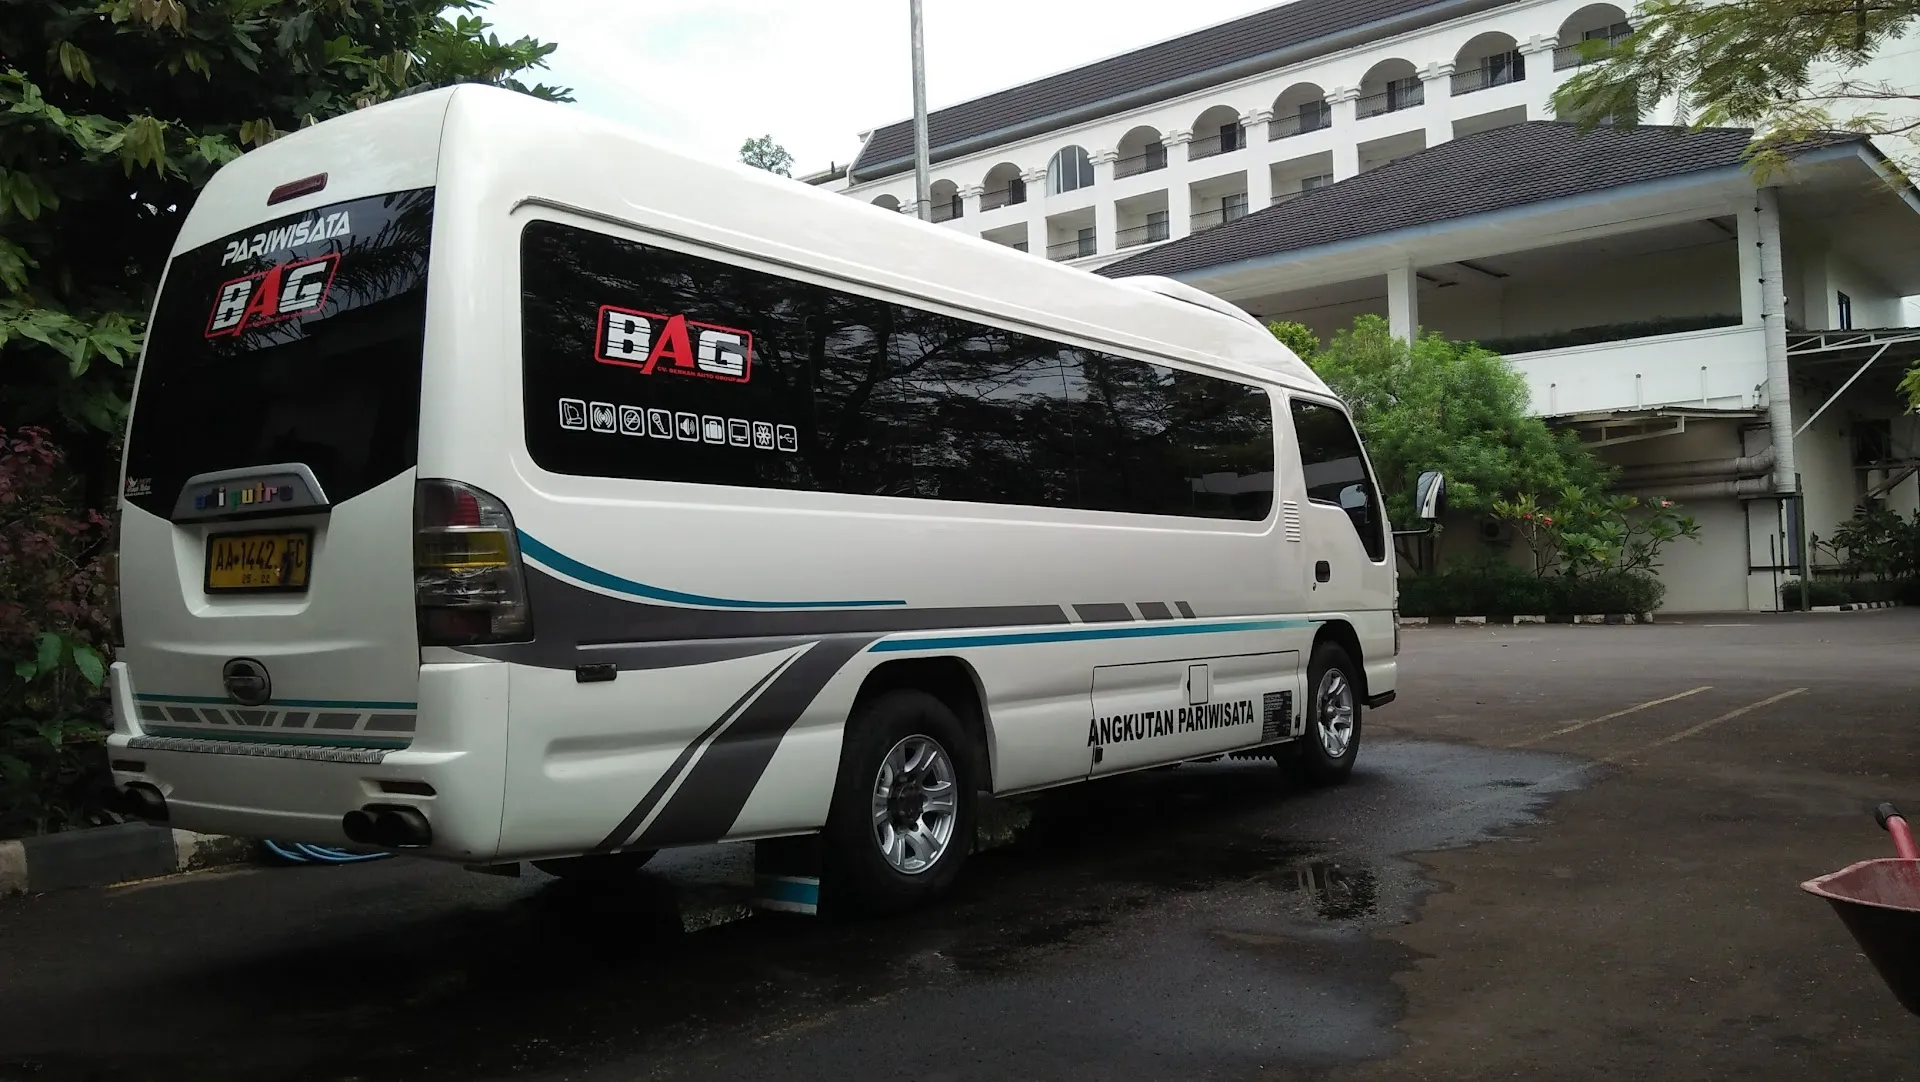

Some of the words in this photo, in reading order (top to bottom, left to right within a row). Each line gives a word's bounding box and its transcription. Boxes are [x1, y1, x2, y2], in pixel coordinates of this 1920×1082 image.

[221, 210, 350, 267] PARIWISATA
[211, 263, 328, 337] BAG
[605, 313, 744, 376] BAG
[241, 540, 275, 570] 1442
[1087, 709, 1174, 748] ANGKUTAN
[1178, 700, 1254, 733] PARIWISATA
